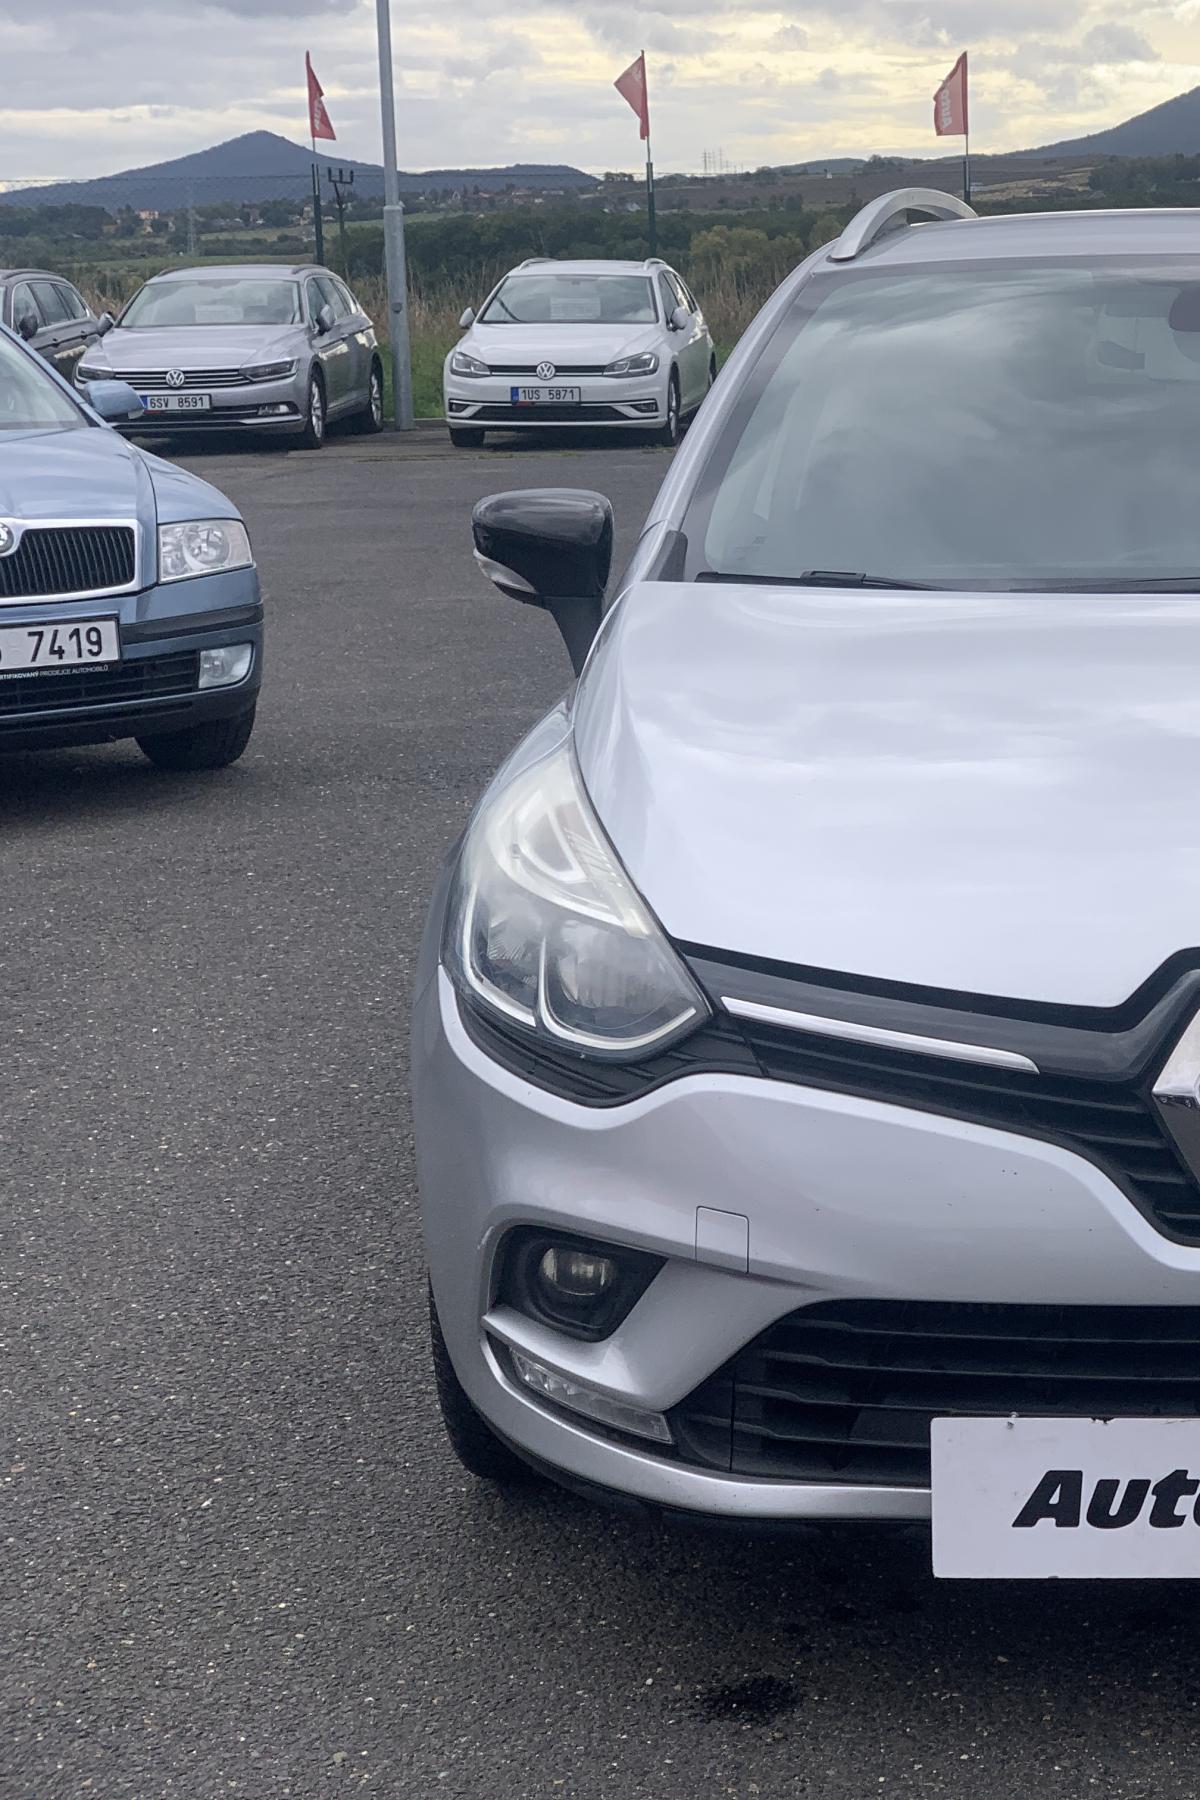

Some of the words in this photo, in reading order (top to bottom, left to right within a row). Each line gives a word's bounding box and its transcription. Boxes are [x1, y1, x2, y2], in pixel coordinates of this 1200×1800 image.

[177, 395, 204, 408] 8591
[548, 389, 574, 401] 5871
[27, 626, 103, 663] 7419
